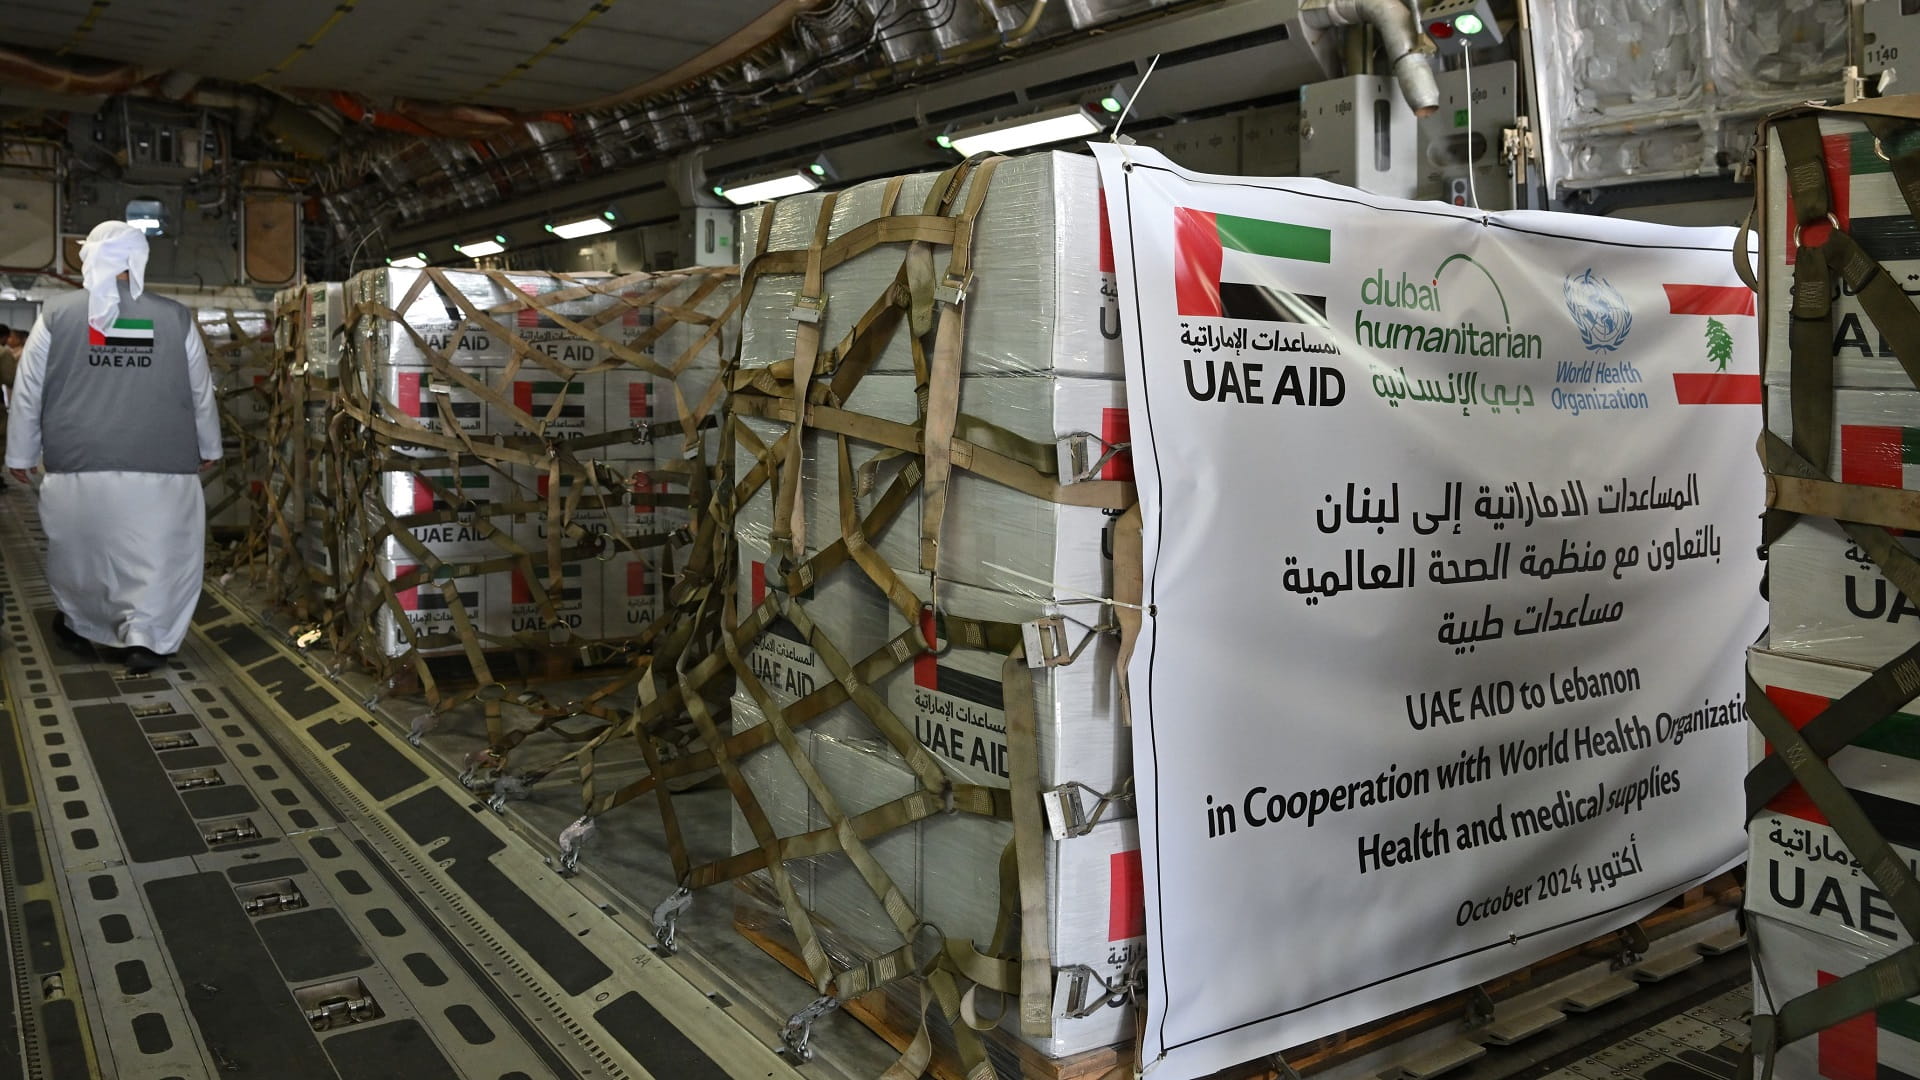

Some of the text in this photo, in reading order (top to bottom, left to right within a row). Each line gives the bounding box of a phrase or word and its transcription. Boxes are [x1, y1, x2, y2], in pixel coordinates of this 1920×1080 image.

[1868, 47, 1898, 64] 1140
[1361, 268, 1441, 312] dubai
[457, 335, 490, 351] AID
[563, 345, 594, 361] AID
[1181, 323, 1340, 356] المساعدات الإماراتية
[1355, 309, 1542, 360] humanitarian
[88, 354, 152, 367] UAE AID
[1184, 360, 1345, 406] UAE AID
[1556, 360, 1642, 383] World Health
[1373, 367, 1534, 416] دبي الإنسانية
[1552, 387, 1648, 416] Organization
[1317, 473, 1699, 535] المساعدات الاماراتية إلى لبنان
[414, 527, 453, 543] UAE
[1283, 525, 1720, 606] بالتعاون مع منظمة الصحة العالمية
[1438, 593, 1623, 655] مساعدات طبية
[752, 653, 815, 698] UAE AID
[1406, 666, 1640, 730] UAE AID to Lebanon
[915, 689, 954, 722] الإماراتية
[915, 715, 965, 763] UAE
[1207, 795, 1236, 838] in
[1243, 763, 1430, 828] Cooperation
[1437, 746, 1491, 790] with
[1499, 728, 1569, 776] World
[1575, 715, 1651, 760] Health
[1359, 765, 1680, 874] Health and medical supplies
[1456, 833, 1643, 926] October 2024 أكتوبر
[1769, 858, 1898, 942] UAE
